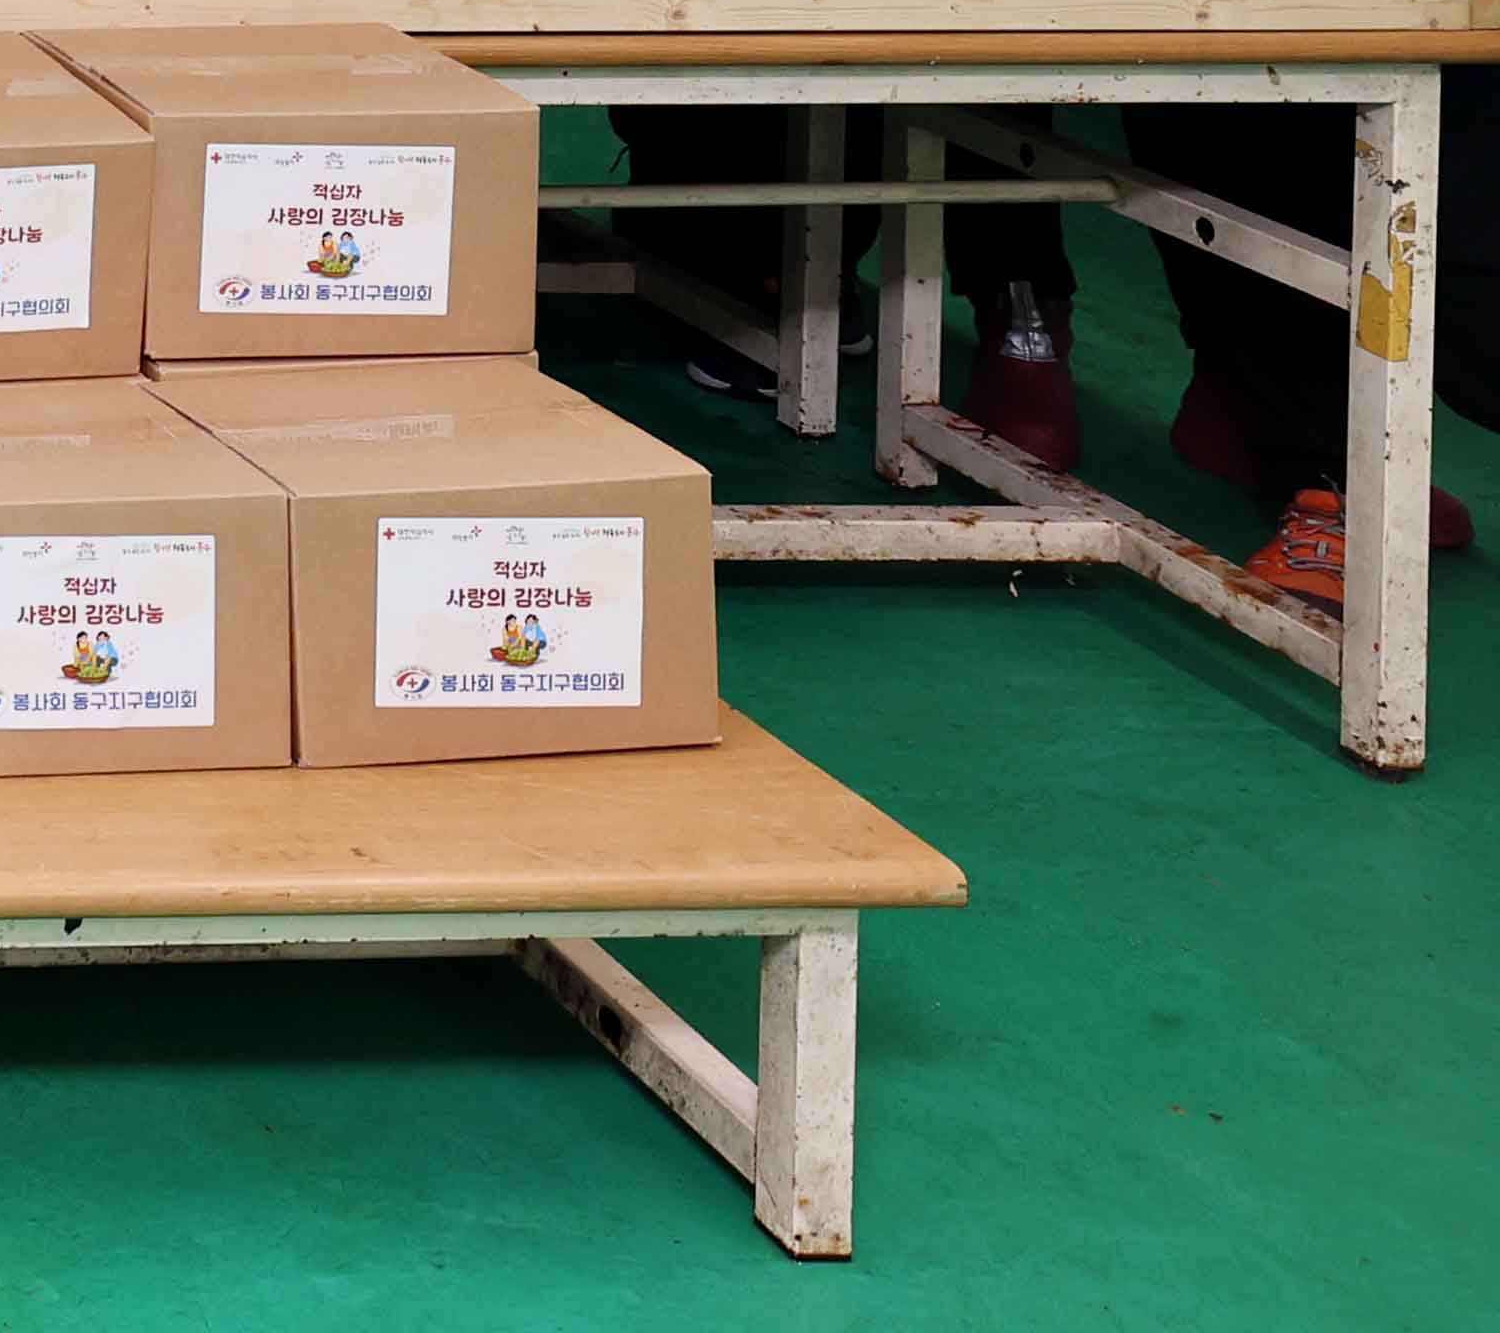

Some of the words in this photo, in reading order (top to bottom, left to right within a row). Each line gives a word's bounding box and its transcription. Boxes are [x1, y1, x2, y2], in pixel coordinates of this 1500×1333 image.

[492, 560, 547, 580] 적십자
[445, 587, 506, 609] 사랑의
[513, 586, 594, 609] 김장나눔
[440, 673, 494, 694] 봉사회
[499, 671, 625, 693] 동구지구협의회
